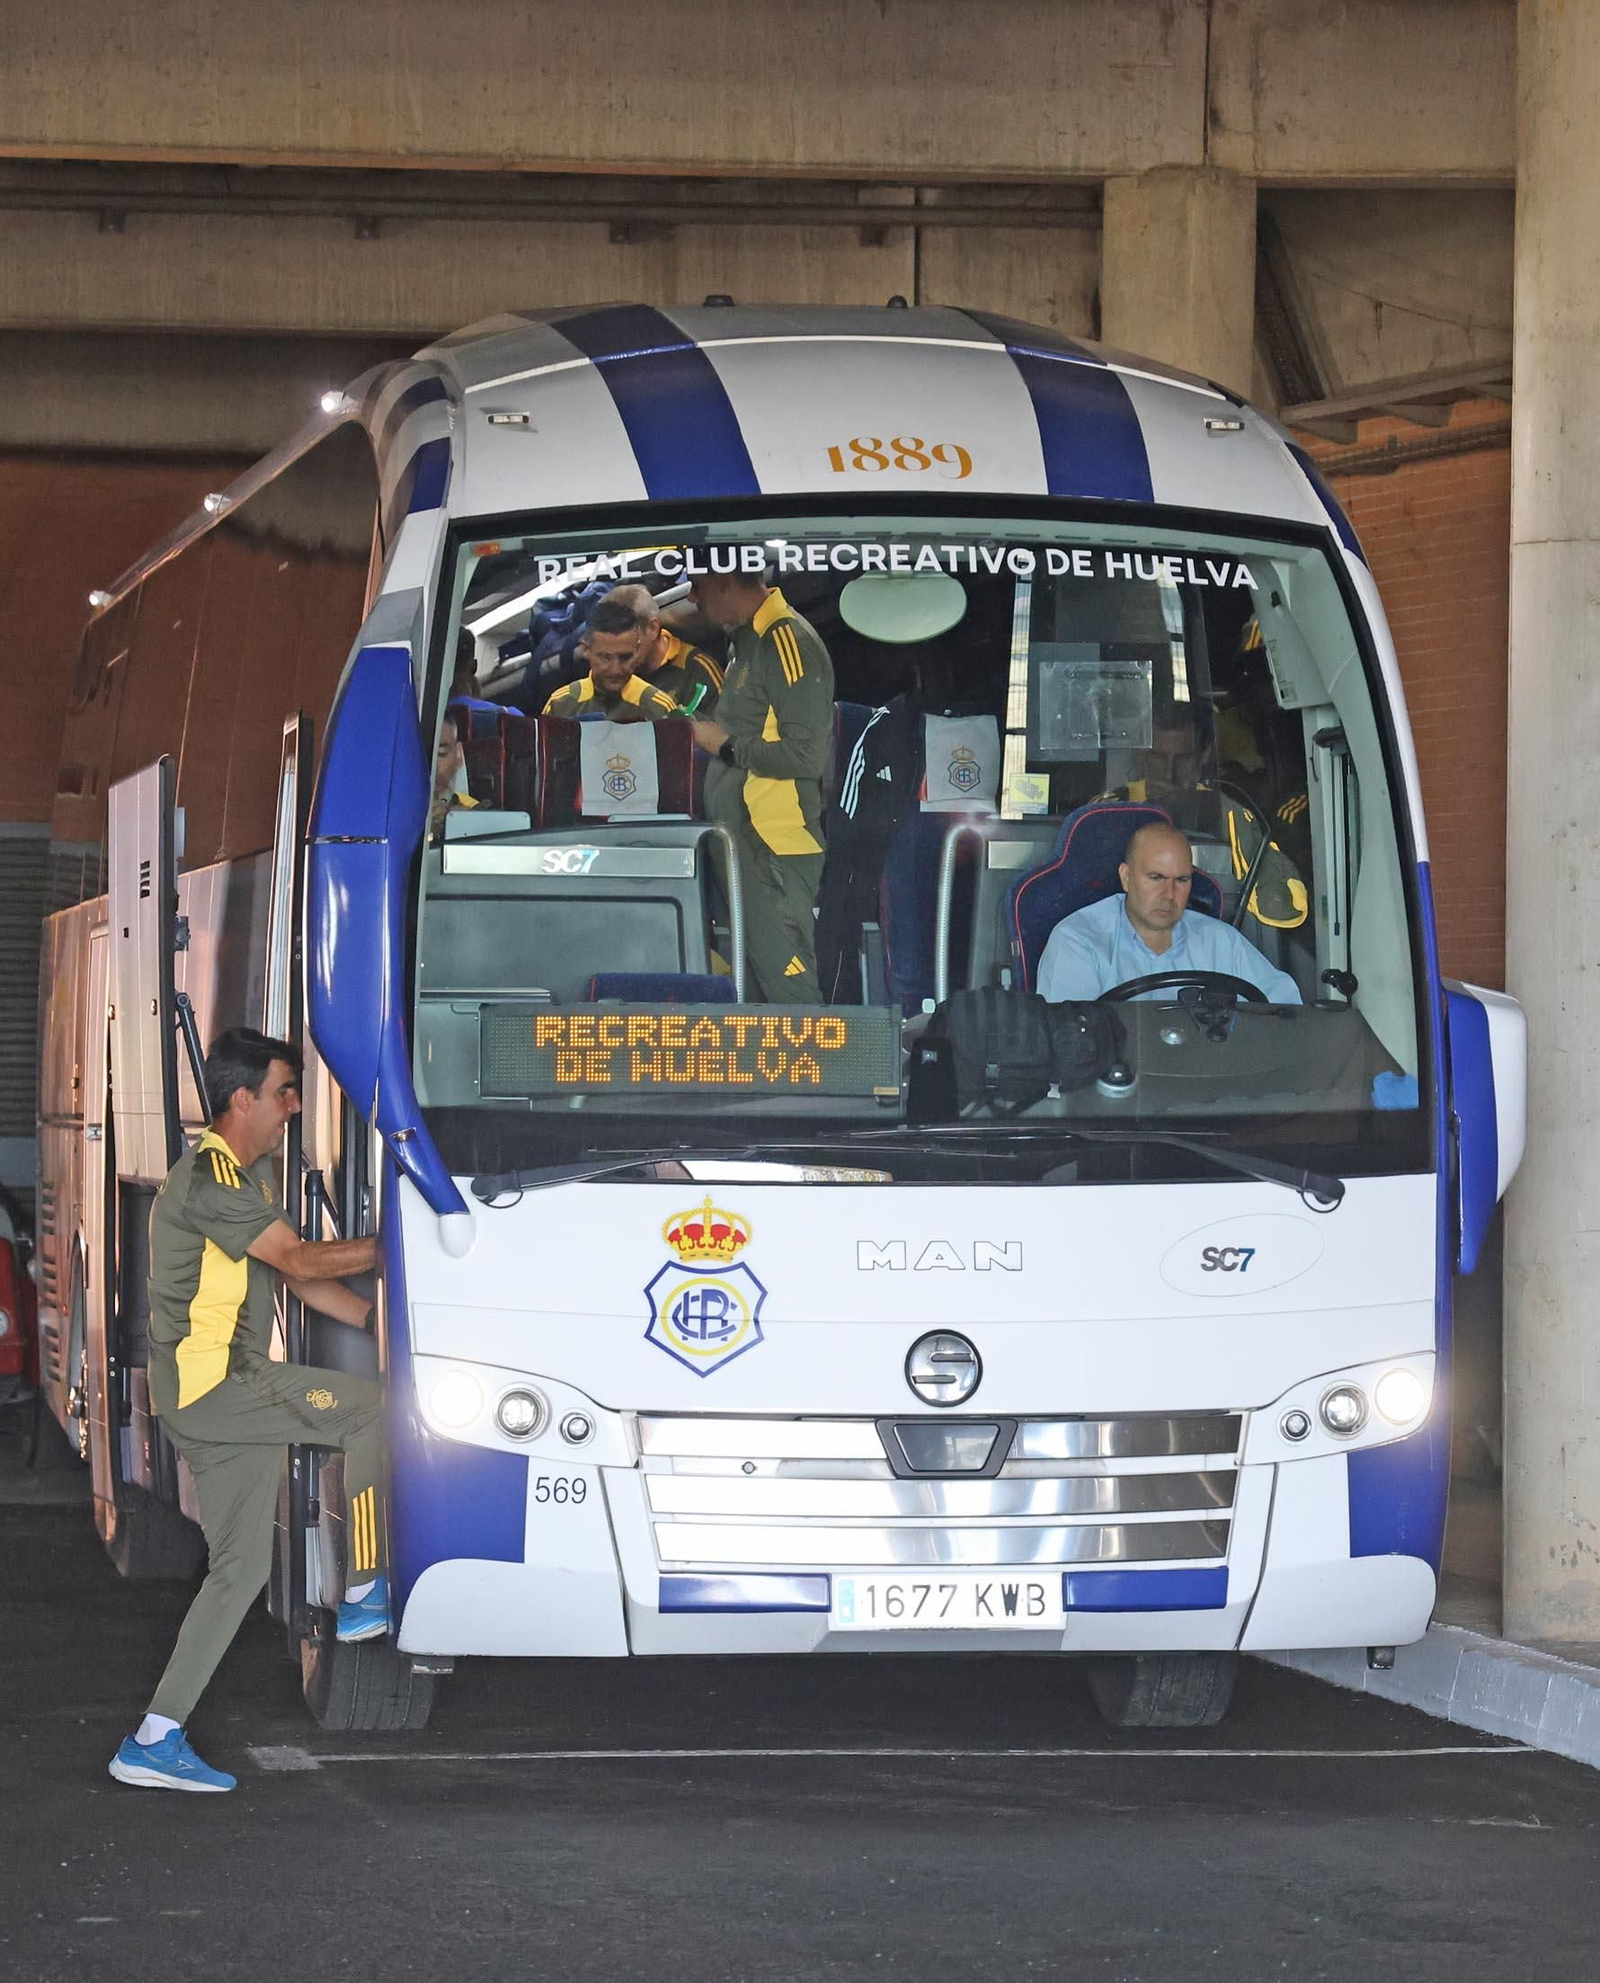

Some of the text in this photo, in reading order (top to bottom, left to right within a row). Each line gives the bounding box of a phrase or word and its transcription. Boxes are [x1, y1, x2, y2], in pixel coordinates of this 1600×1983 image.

[822, 436, 973, 480] 1889
[537, 543, 1259, 590] REAL CLUB RECREATIVO DE HUELVA
[541, 849, 600, 875] SC7
[535, 1015, 847, 1049] RECREATIVO
[555, 1051, 821, 1084] DE HUELVA
[856, 1239, 1023, 1272] MAN
[1200, 1246, 1256, 1272] SC7
[534, 1476, 588, 1505] 569
[866, 1583, 1046, 1619] 1677 KWB
